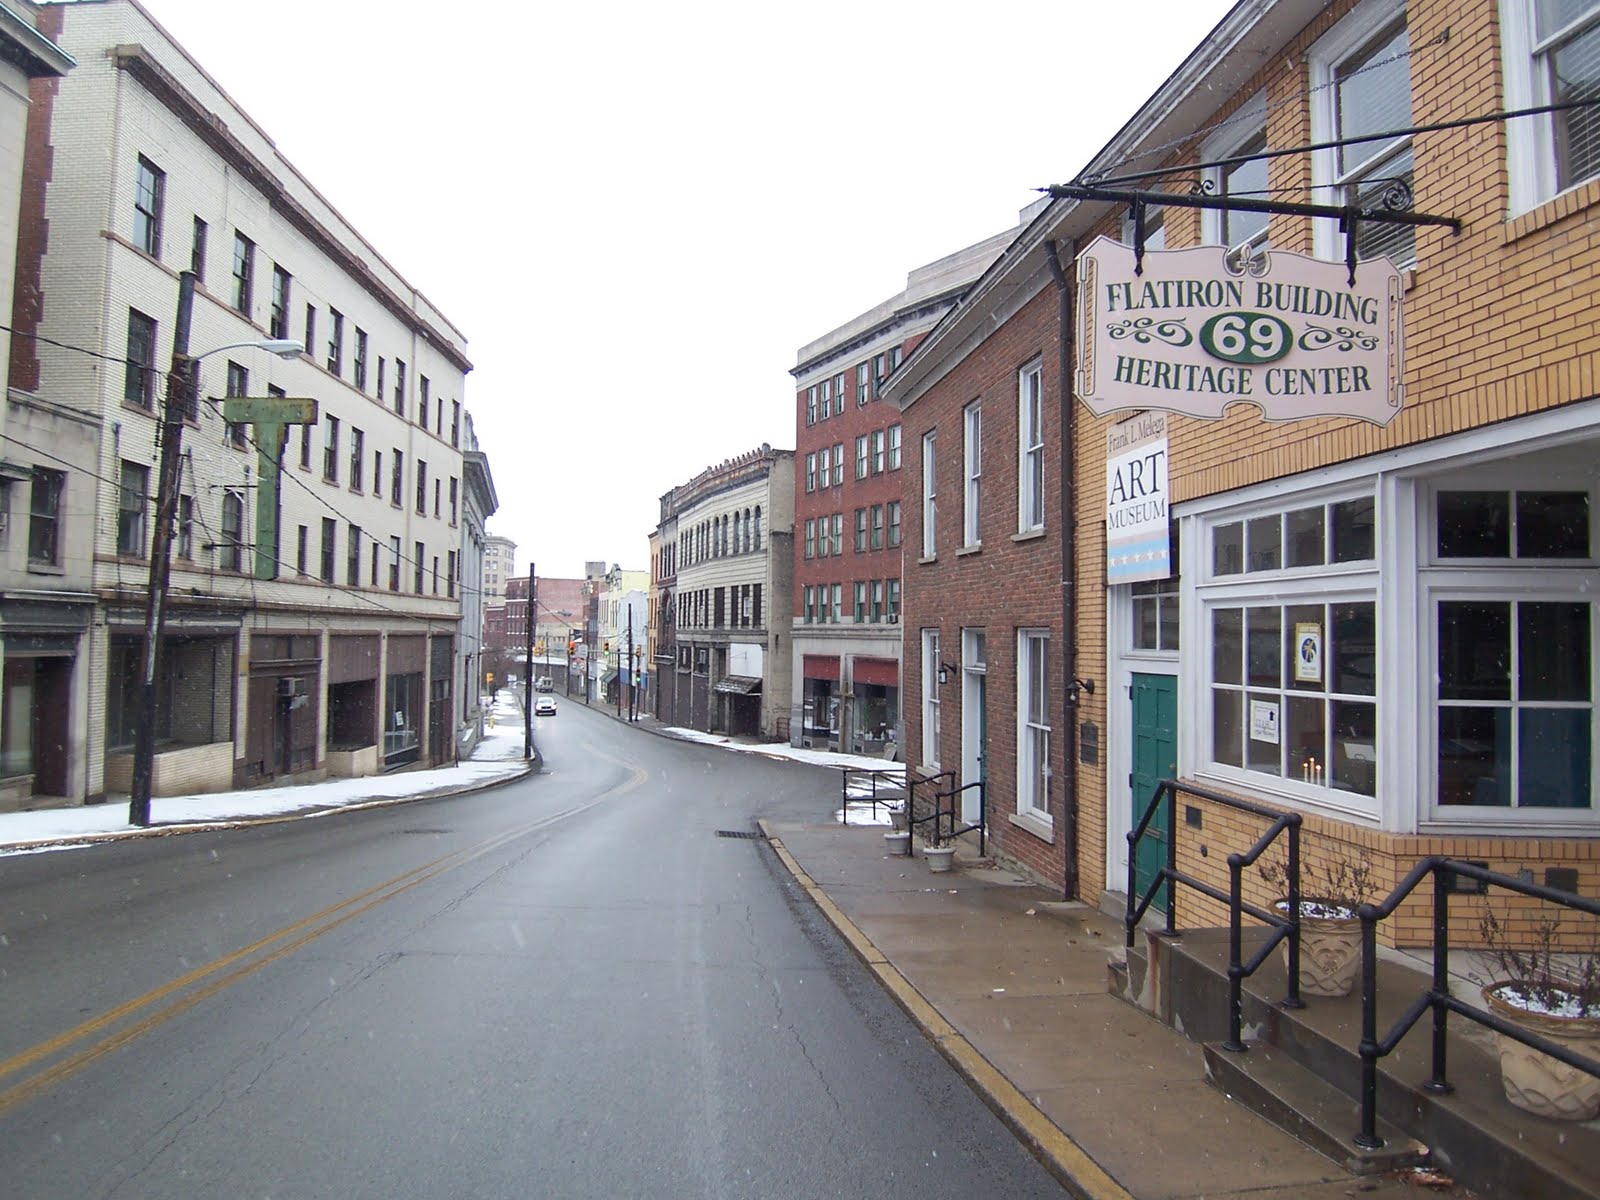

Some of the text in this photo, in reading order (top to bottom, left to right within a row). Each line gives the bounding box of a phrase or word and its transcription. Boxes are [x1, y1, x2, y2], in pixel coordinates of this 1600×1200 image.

[1106, 279, 1379, 325] FLATIRON BUILDING
[1212, 315, 1284, 358] 69
[1113, 355, 1372, 396] HERITAGE CENTER
[1108, 424, 1129, 453] Frank
[1138, 413, 1165, 439] Melega
[1109, 450, 1165, 506] ART
[1108, 498, 1166, 531] MUSEUM
